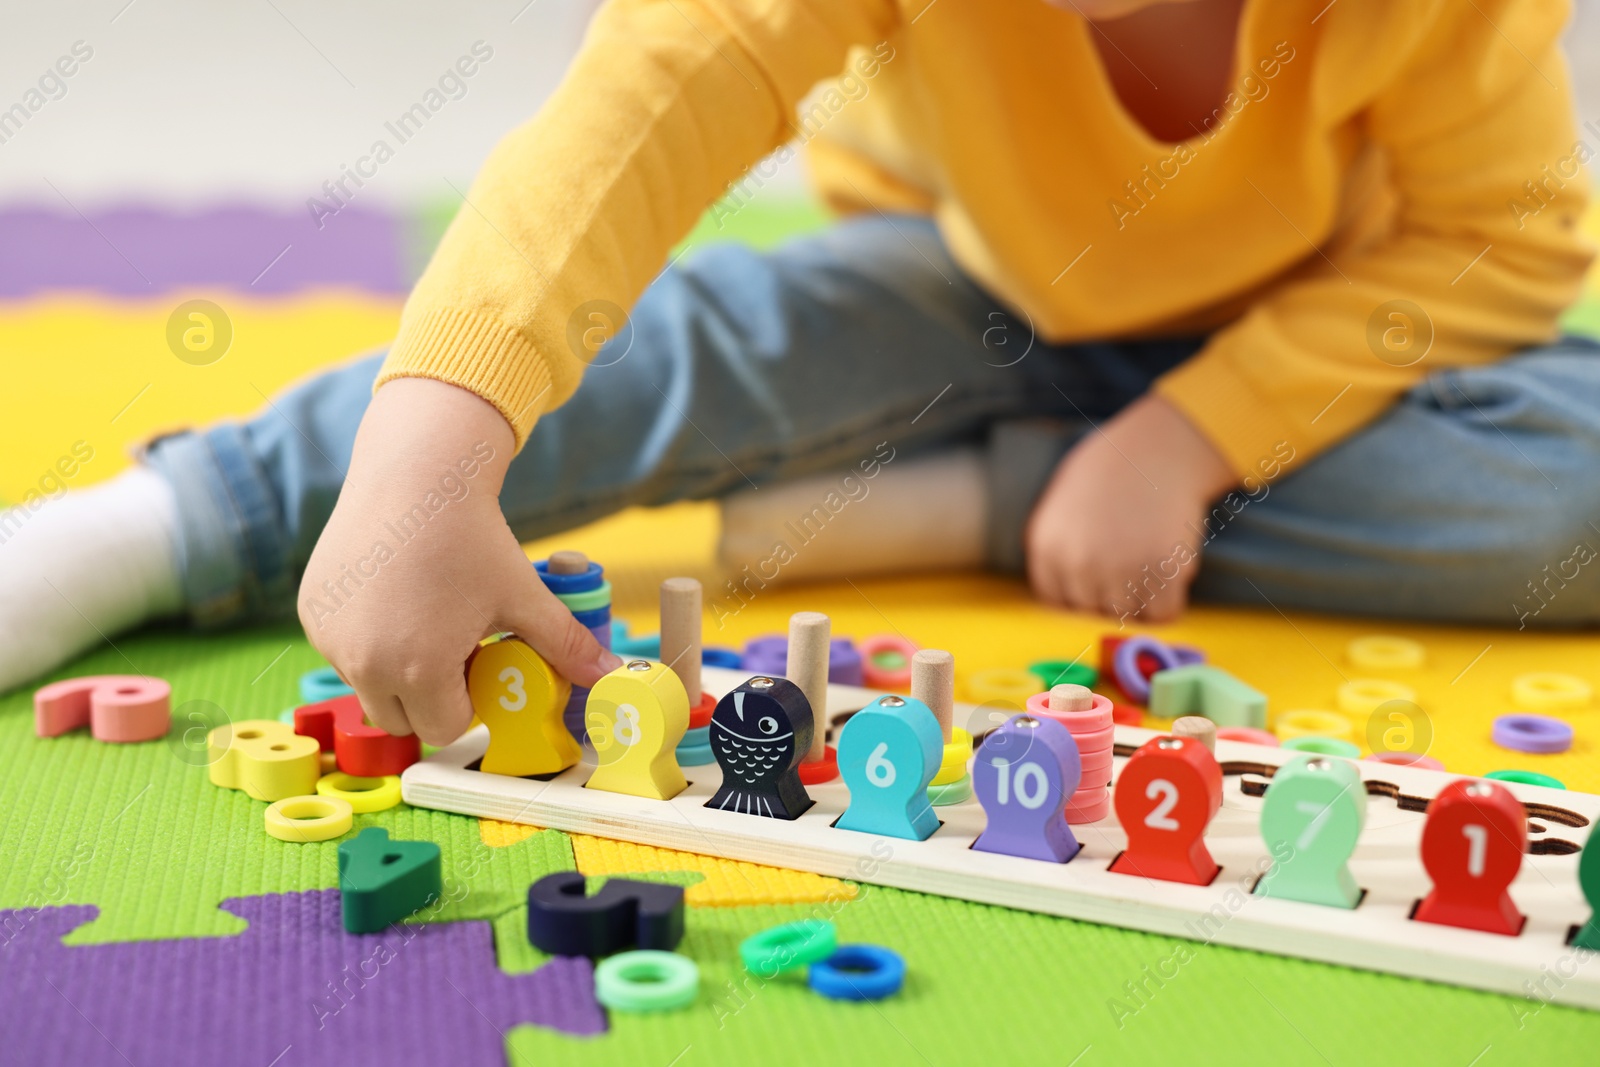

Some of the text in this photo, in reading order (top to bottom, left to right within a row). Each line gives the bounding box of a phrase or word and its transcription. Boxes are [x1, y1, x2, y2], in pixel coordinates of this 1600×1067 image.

[498, 666, 527, 712] 3
[613, 703, 642, 746] 8
[865, 742, 896, 788] 6
[991, 757, 1049, 810] 10
[1144, 779, 1179, 831] 2
[1296, 801, 1332, 850] 7
[1461, 824, 1488, 878] 1
